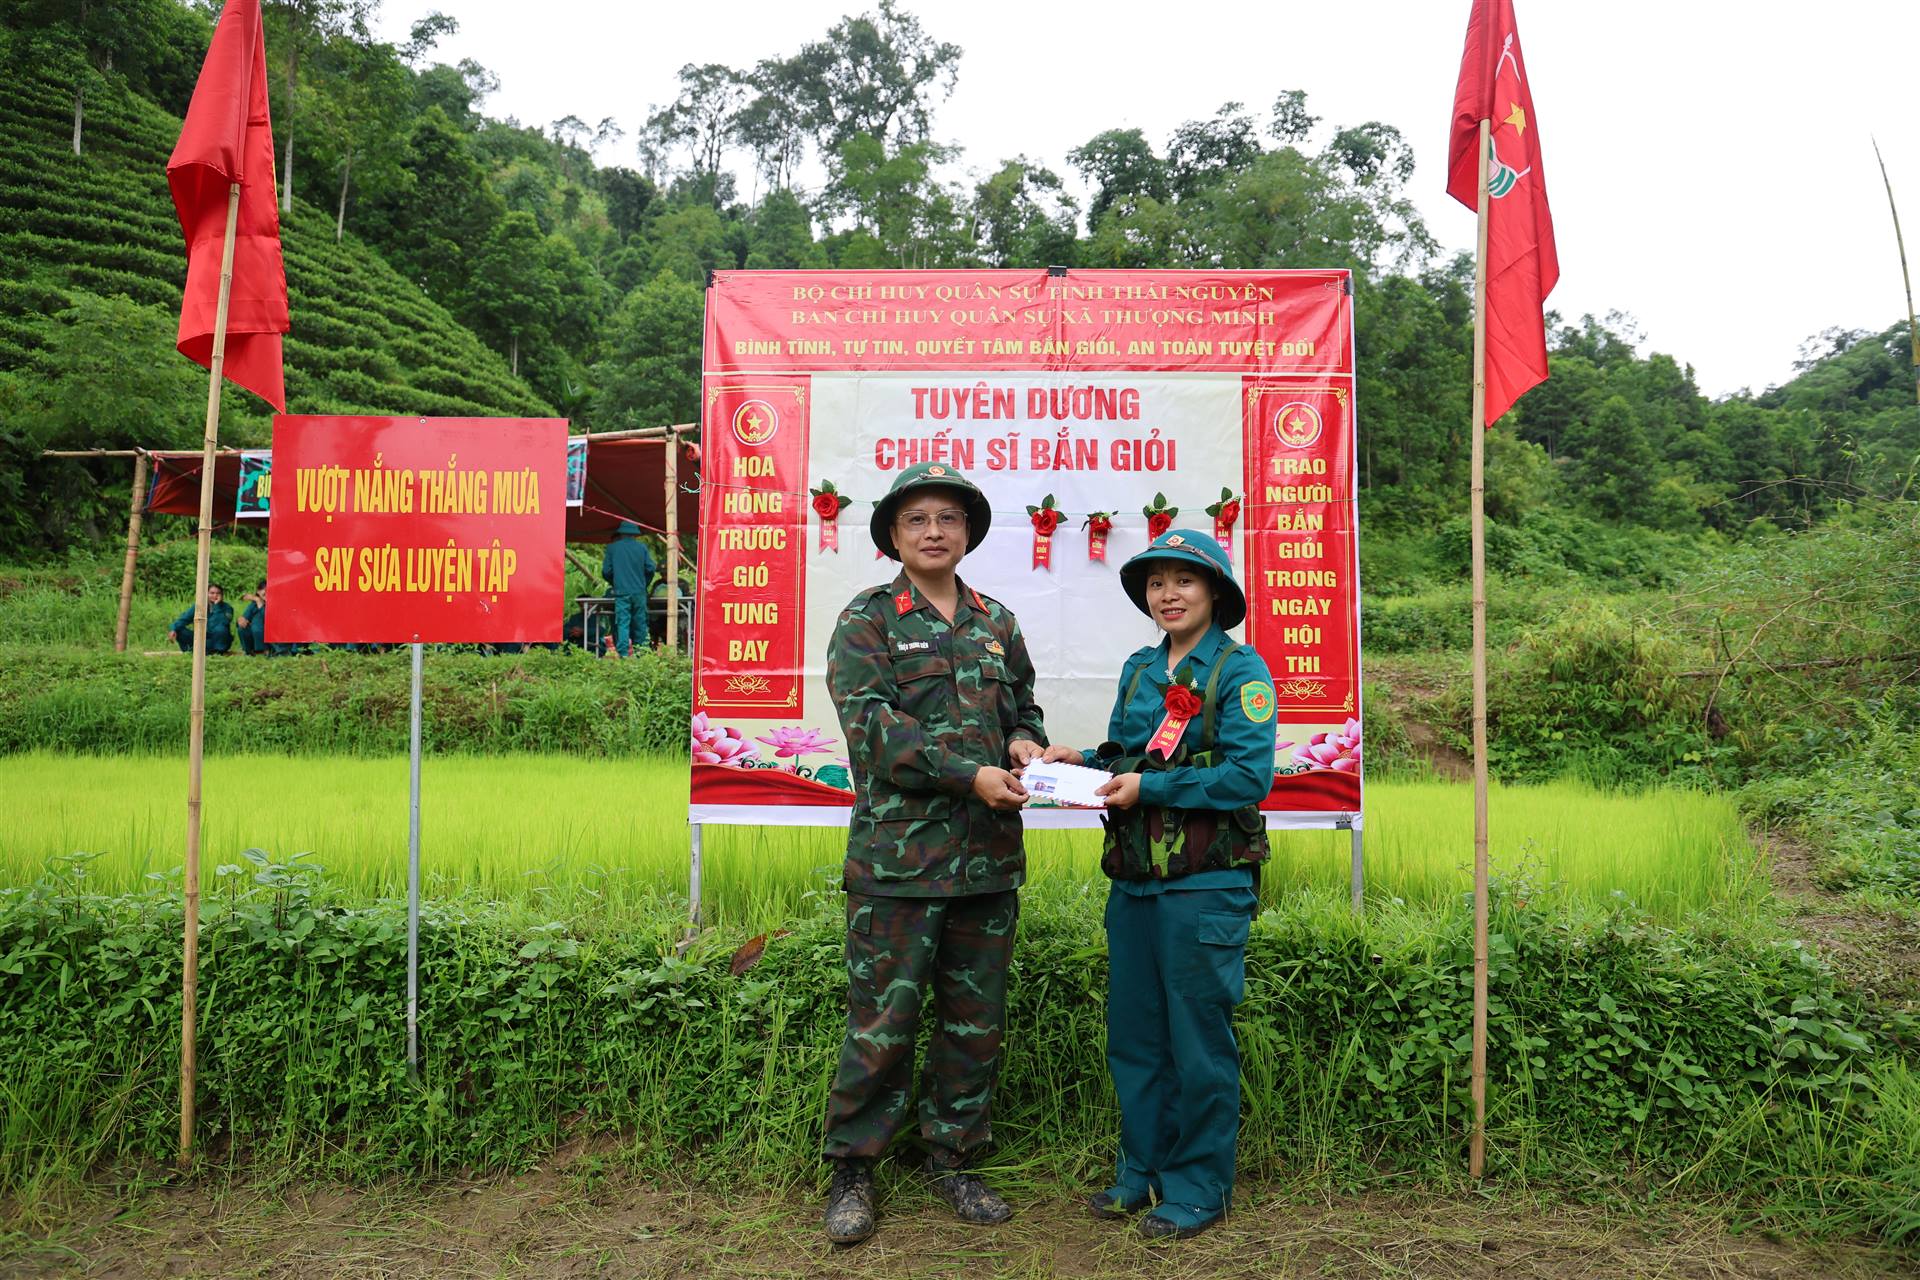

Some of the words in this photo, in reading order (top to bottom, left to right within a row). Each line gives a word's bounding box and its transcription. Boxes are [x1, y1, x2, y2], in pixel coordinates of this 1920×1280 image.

[793, 284, 825, 304] BỘ
[830, 281, 873, 300] CHỈ
[880, 285, 929, 300] HUY
[935, 282, 1001, 303] QUÂN
[1009, 284, 1041, 304] SỰ
[1110, 282, 1168, 300] THÁI
[1175, 283, 1275, 301] NGUYÊN
[791, 310, 838, 325] BAN
[845, 306, 888, 325] CHỈ
[895, 310, 943, 325] HUY
[949, 306, 1017, 328] QUÂN
[1023, 308, 1056, 328] SỰ
[1062, 307, 1094, 324] XÃ
[1100, 308, 1204, 328] THƯỢNG
[1211, 310, 1275, 325] MINH
[735, 338, 781, 355] BÌNH
[787, 337, 837, 358] TĨNH,
[843, 338, 868, 358] TỰ
[872, 340, 909, 357] TIN,
[915, 335, 976, 356] QUYẾT
[981, 337, 1023, 355] TÂM
[1030, 336, 1069, 356] BẮN
[1076, 336, 1121, 357] GIỎI,
[1128, 341, 1155, 355] AN
[1161, 338, 1213, 355] TOÀN
[1218, 338, 1276, 360] TUYỆT
[1282, 337, 1316, 357] ĐỐI
[911, 381, 1015, 420] TUYÊN
[1027, 385, 1141, 421] DƯƠNG
[875, 428, 974, 471] CHIẾN
[986, 431, 1021, 471] SĨ
[1030, 426, 1098, 471] BẮN
[1110, 428, 1176, 471] GIỎI
[733, 455, 776, 478] HOA
[1271, 458, 1327, 475] TRAO
[296, 464, 350, 523] VƯỢT
[353, 452, 414, 514] NẮNG
[419, 453, 488, 515] THẮNG
[492, 466, 540, 515] MƯA
[1265, 482, 1333, 504] NGƯỜI
[724, 486, 782, 514] HỒNG
[1278, 508, 1324, 531] BẮN
[718, 525, 787, 551] TRƯỚC
[1279, 537, 1324, 559] GIỎI
[314, 546, 354, 592] SAY
[358, 543, 401, 592] SƯA
[406, 538, 473, 603] LUYỆN
[477, 538, 517, 603] TẬP
[733, 561, 769, 588] GIÓ
[1264, 570, 1337, 588] TRONG
[721, 602, 779, 625] TUNG
[1272, 595, 1332, 616] NGÀY
[1283, 624, 1321, 648] HỘI
[728, 639, 770, 662] BAY
[1285, 656, 1320, 673] THI
